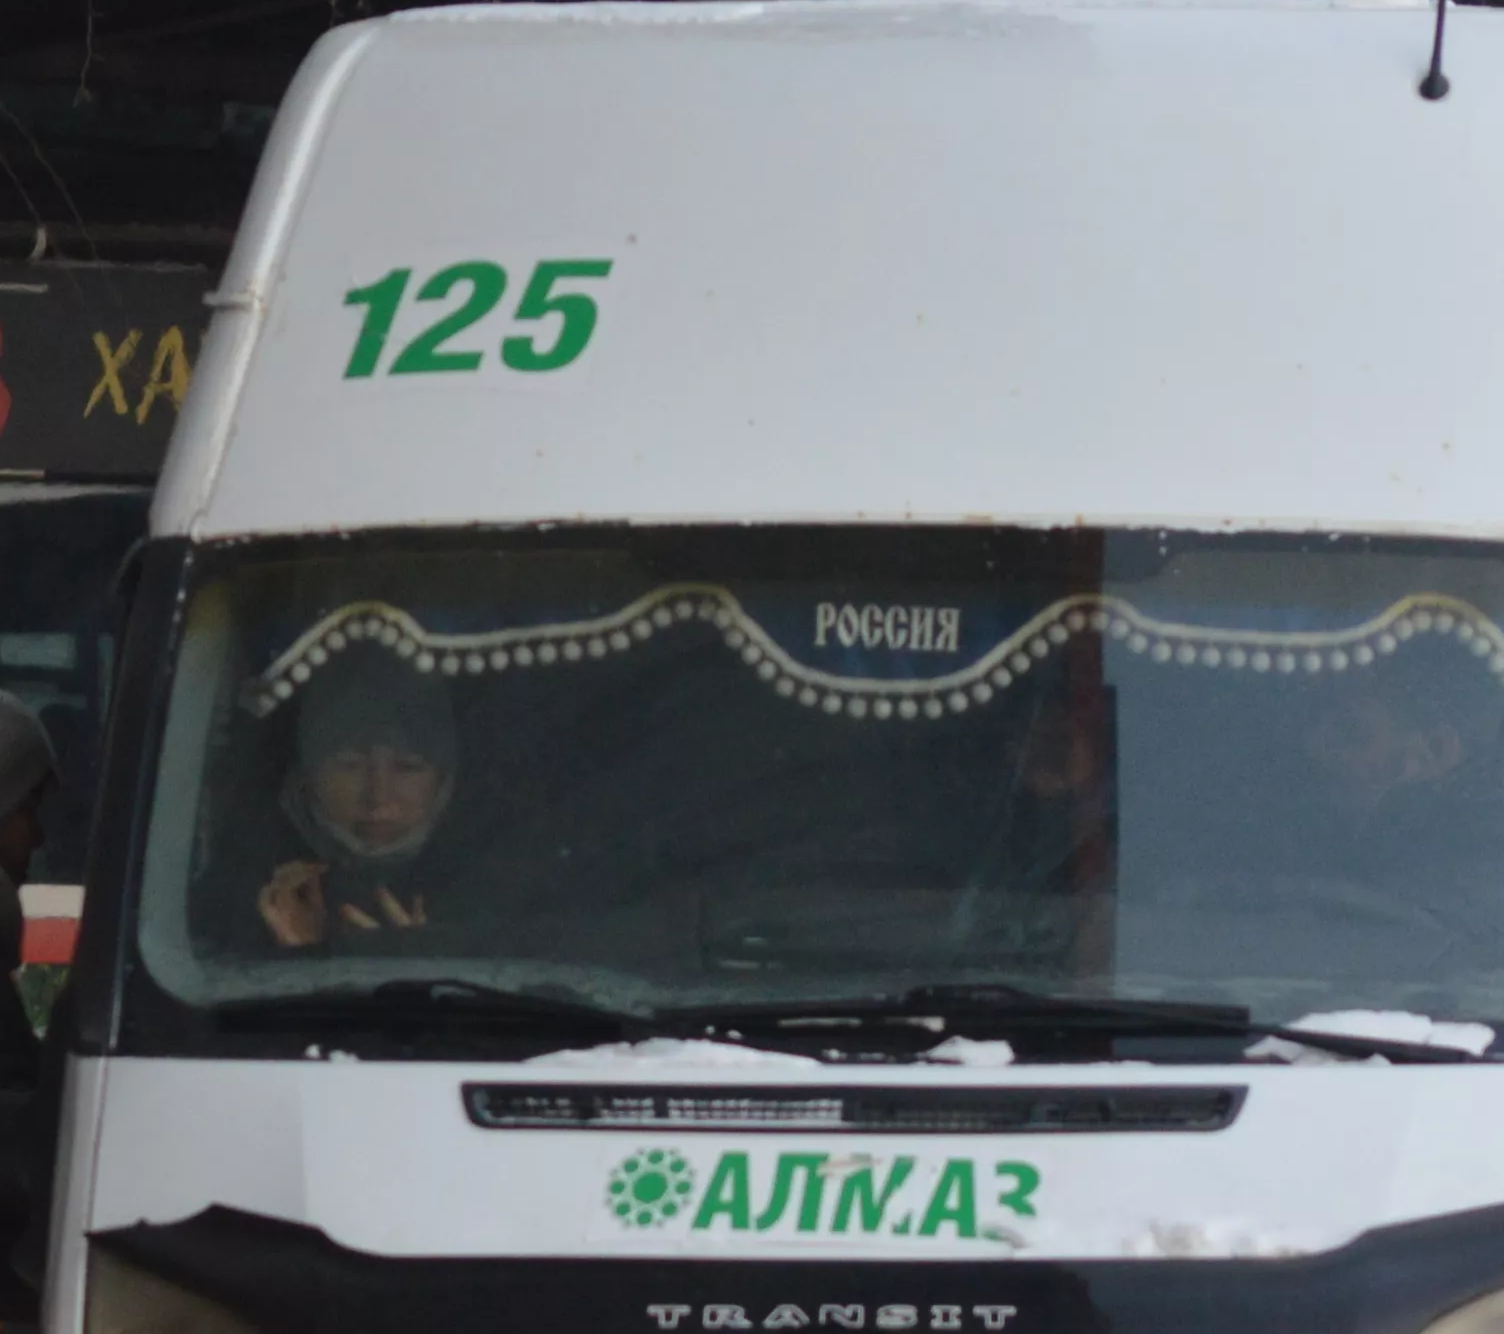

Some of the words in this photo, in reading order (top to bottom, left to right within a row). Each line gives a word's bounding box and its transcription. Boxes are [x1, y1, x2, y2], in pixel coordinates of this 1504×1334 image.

[342, 258, 614, 380] 125
[83, 324, 193, 426] ХА
[812, 600, 962, 653] РОССИЯ
[647, 1304, 1017, 1331] TRANSIT
